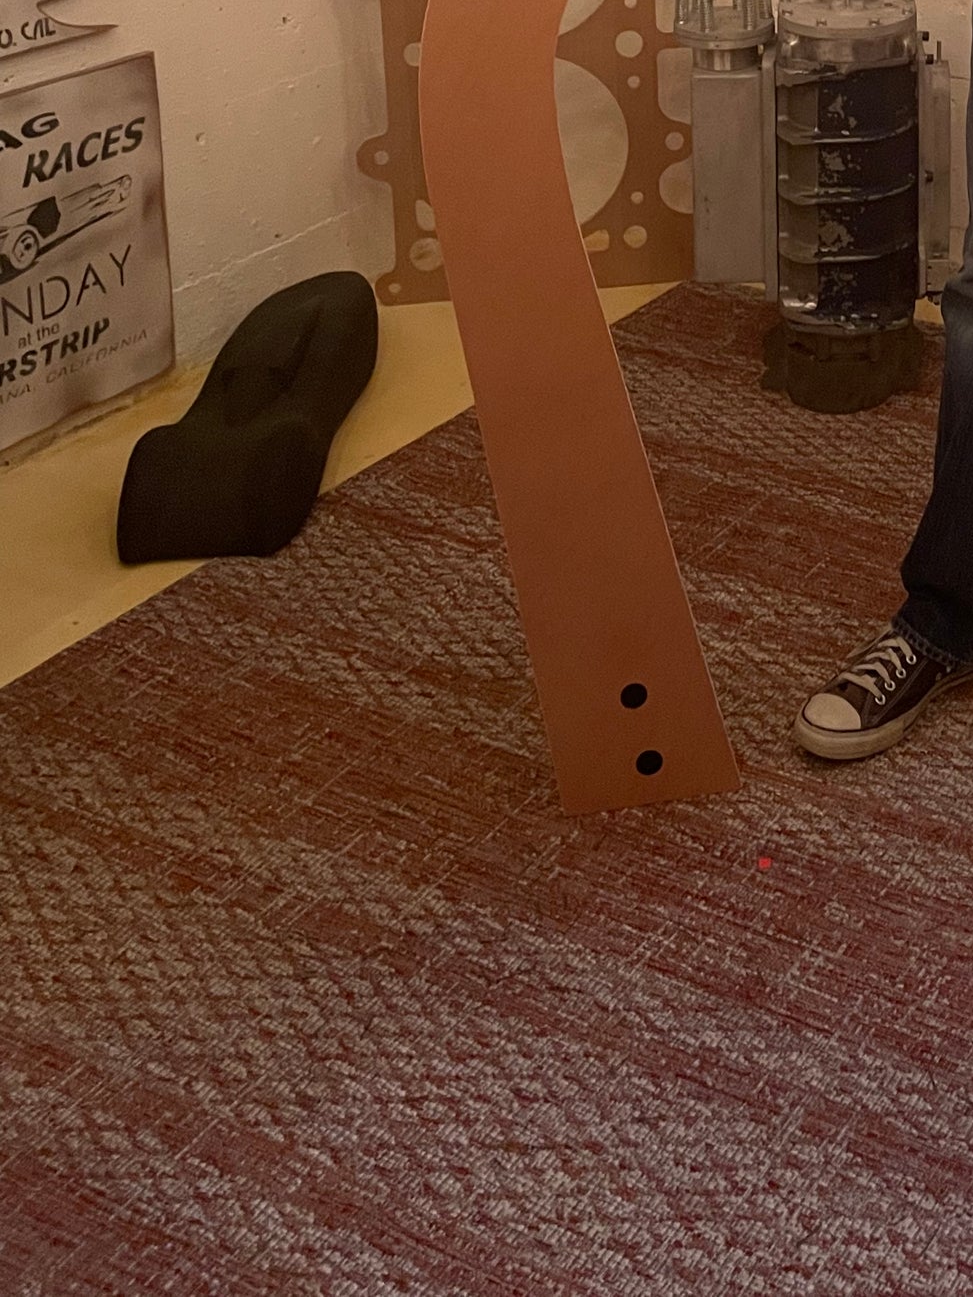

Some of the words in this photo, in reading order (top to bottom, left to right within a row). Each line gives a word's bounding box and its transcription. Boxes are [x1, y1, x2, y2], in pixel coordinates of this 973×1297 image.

[22, 116, 145, 188] RACES
[18, 332, 32, 349] at
[36, 323, 60, 341] the
[46, 329, 148, 383] CALIFORNIA
